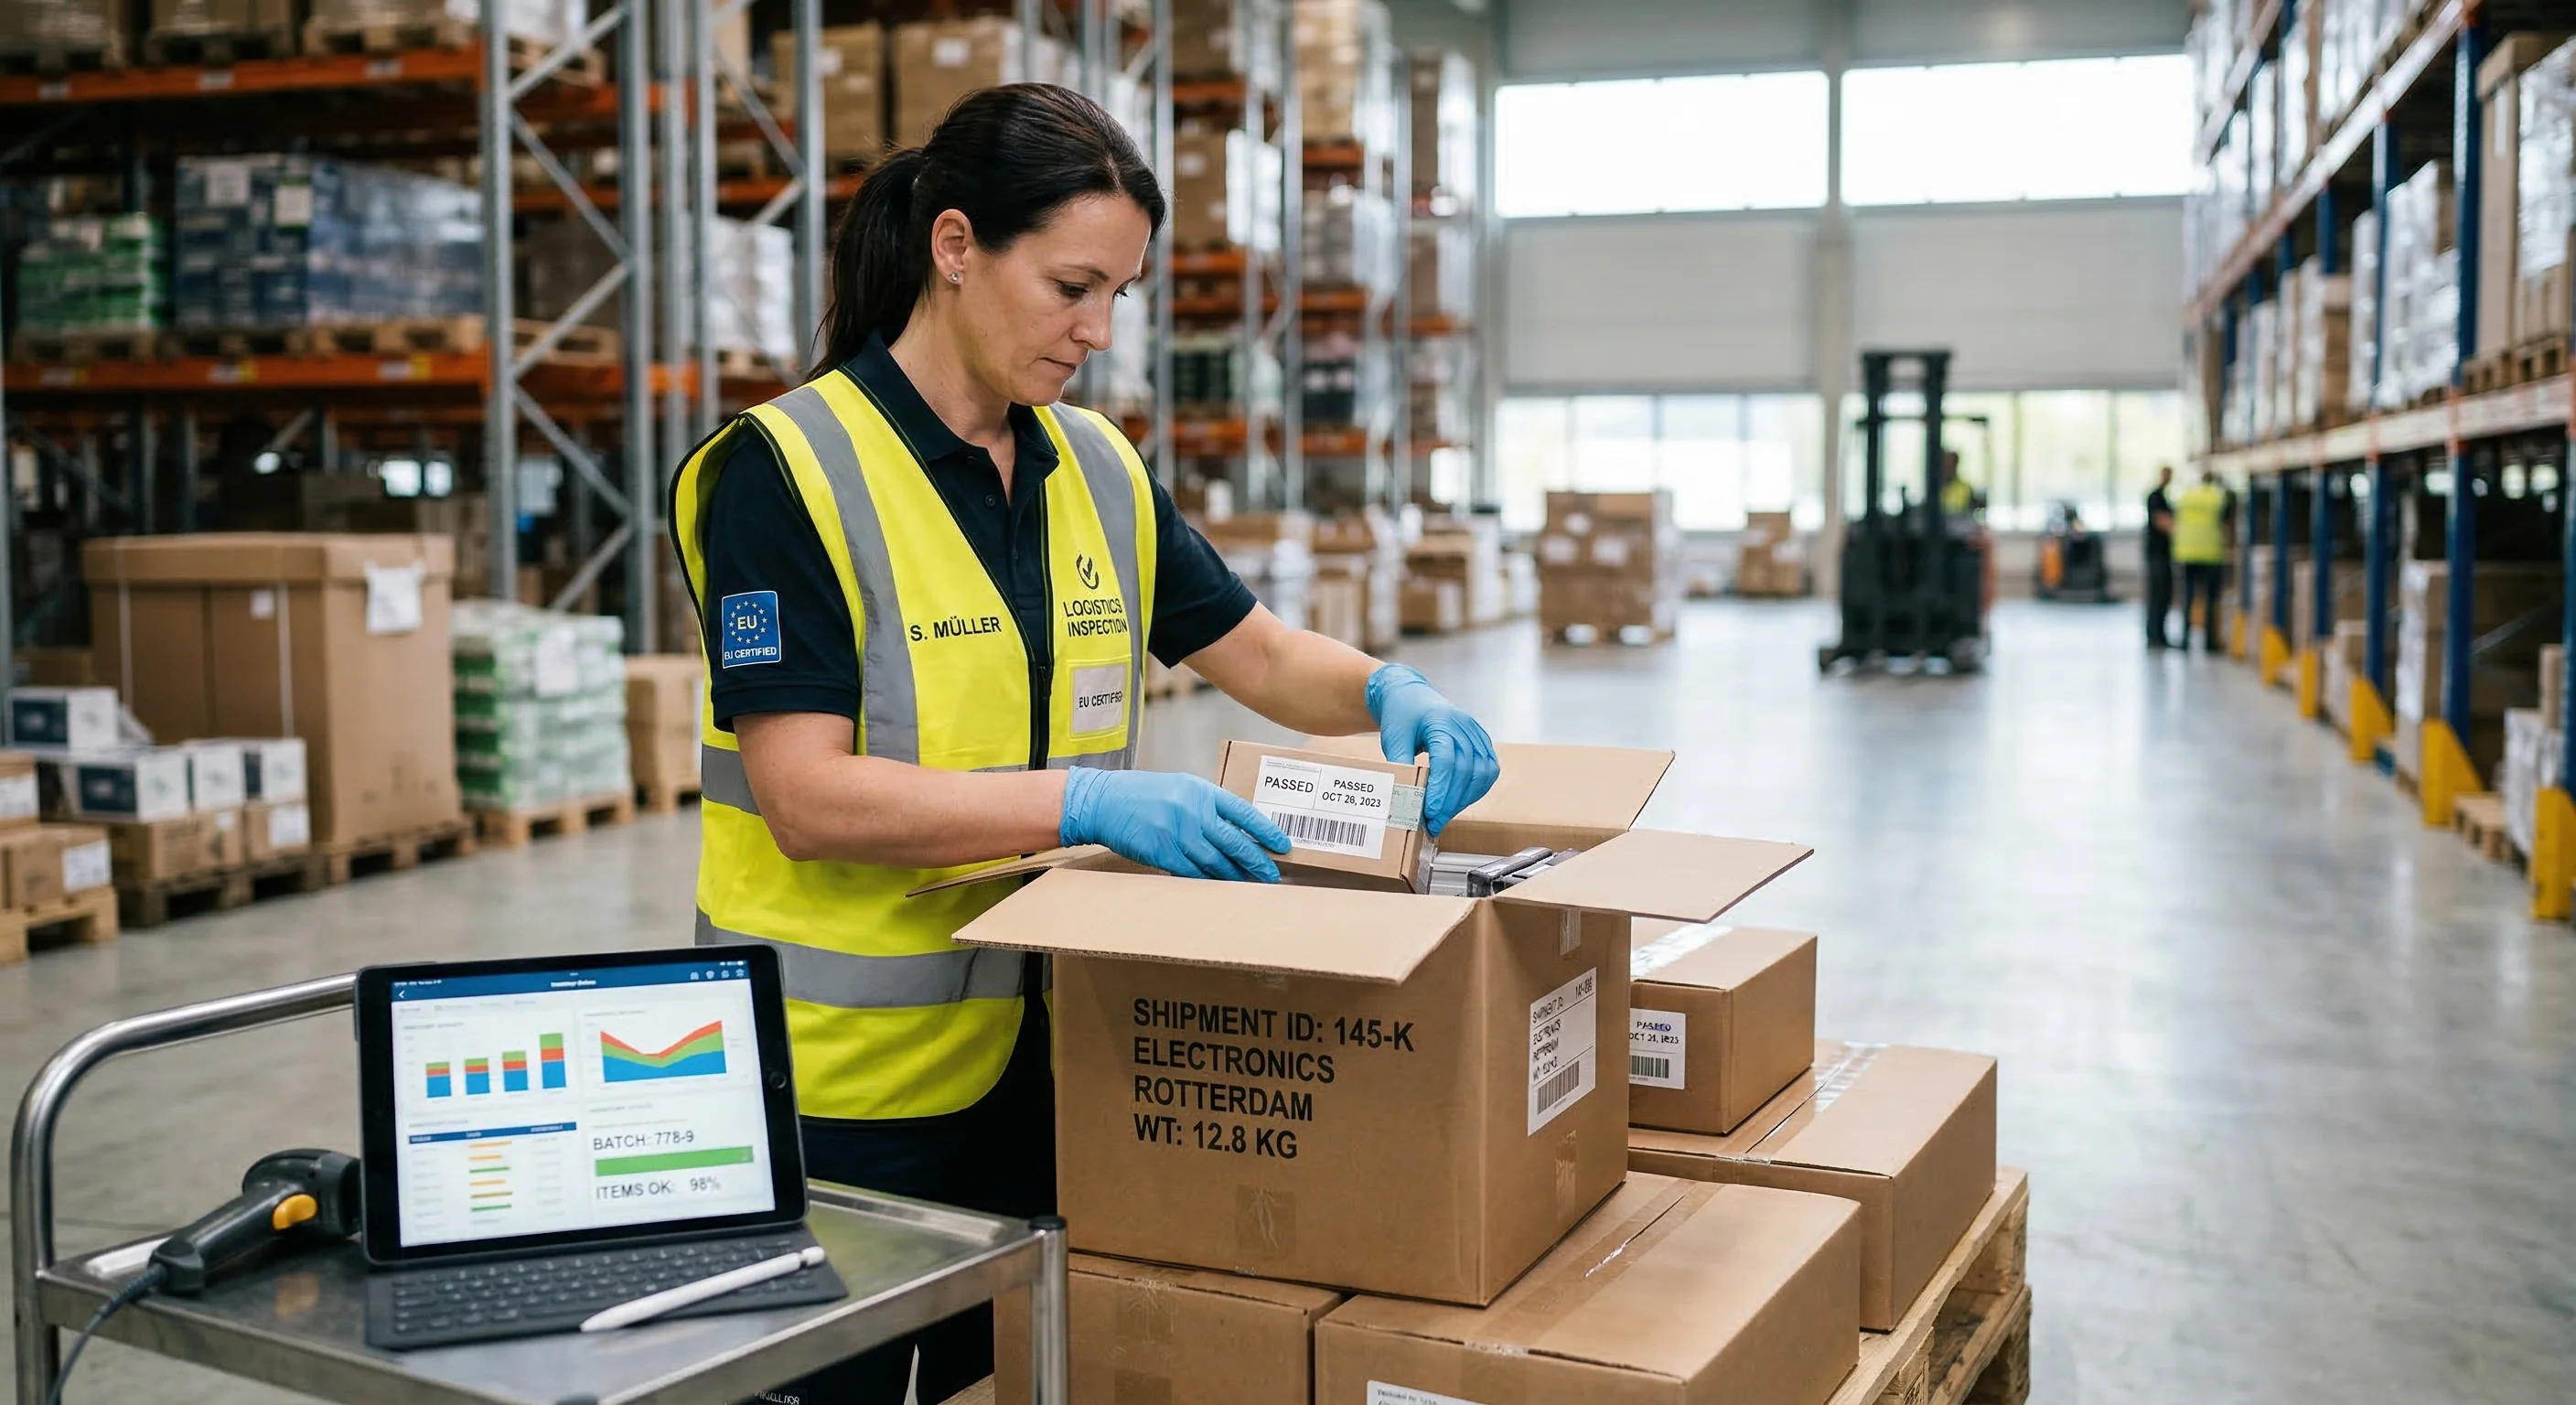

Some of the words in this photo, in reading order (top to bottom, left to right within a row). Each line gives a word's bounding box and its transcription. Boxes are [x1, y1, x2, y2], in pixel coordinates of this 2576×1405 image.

[737, 615, 757, 630] EU
[910, 624, 928, 641] S.
[933, 616, 1002, 638] MÜLLER
[735, 646, 777, 659] CERTIFIED
[1264, 777, 1314, 793] PASSED
[1334, 779, 1374, 793] PASSED
[1322, 791, 1342, 802] OCT
[1360, 797, 1381, 808] 2023
[1133, 998, 1278, 1038] SHIPMENT
[1287, 1012, 1324, 1043] ID:
[1334, 1016, 1415, 1052] 145-K
[1134, 1036, 1336, 1084] ELECTRONICS
[1134, 1075, 1313, 1121] ROTTERDAM
[655, 1130, 695, 1145] 778-9
[1133, 1113, 1183, 1145] WT:
[1193, 1121, 1246, 1153] 12.8
[1256, 1128, 1298, 1159] KG
[596, 1183, 644, 1200] ITEMS
